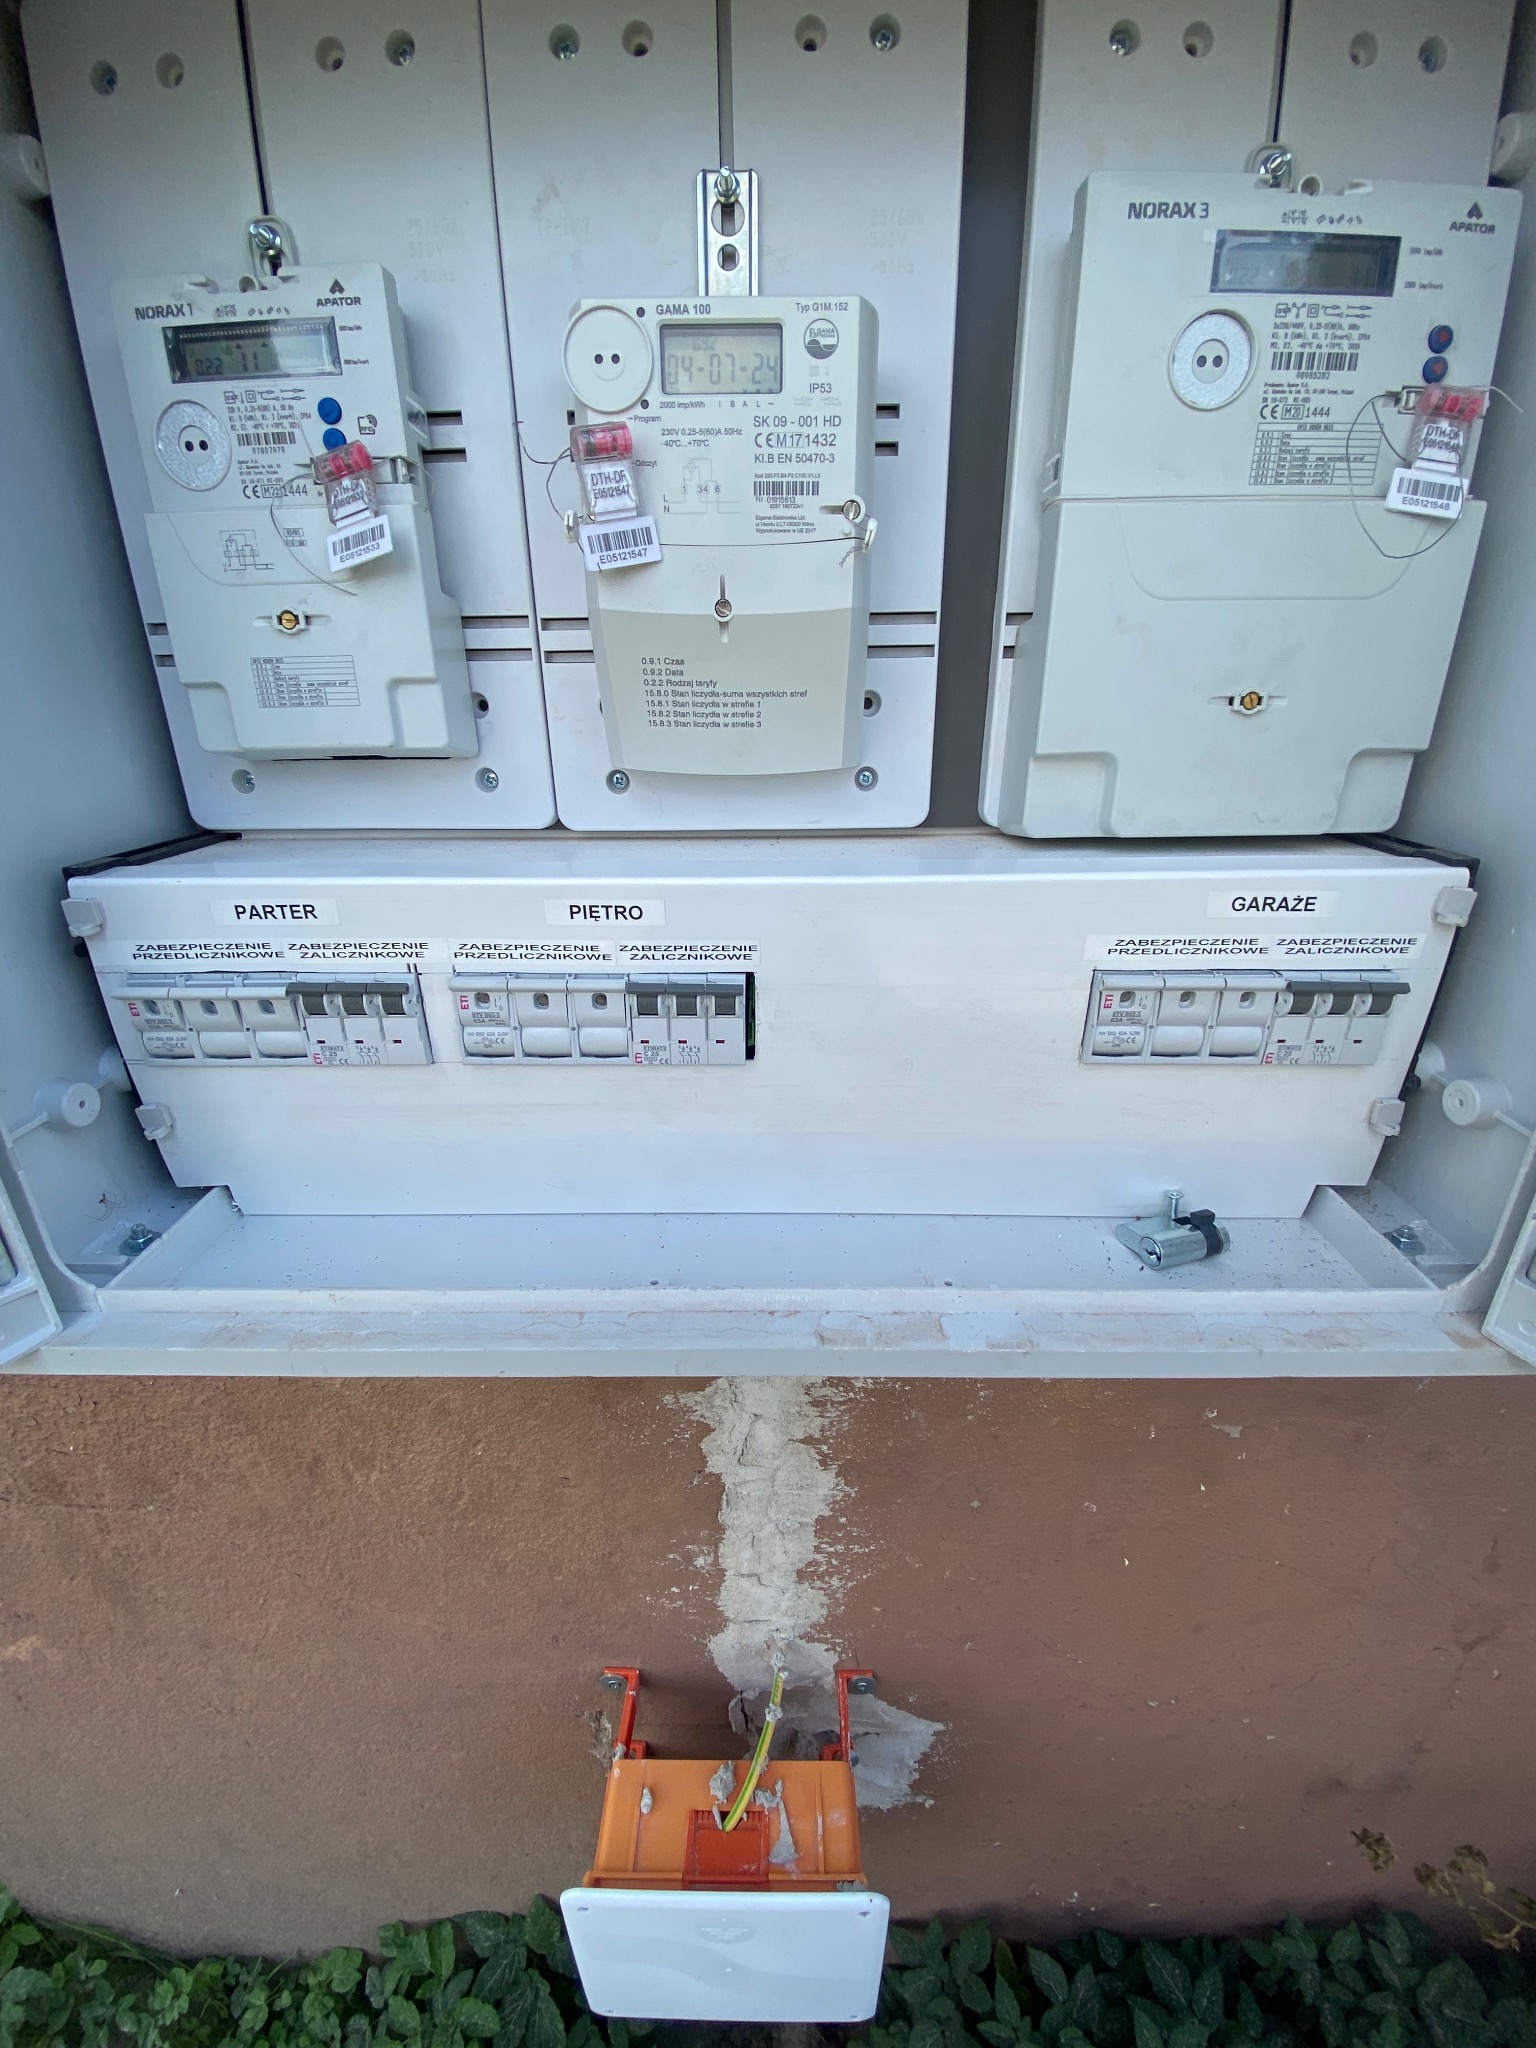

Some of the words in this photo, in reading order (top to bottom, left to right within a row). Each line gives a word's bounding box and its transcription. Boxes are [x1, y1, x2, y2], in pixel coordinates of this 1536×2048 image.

[1450, 222, 1495, 234] APATOR
[316, 296, 362, 308] APATOR
[796, 303, 810, 312] Typ
[812, 303, 848, 311] G1M.152
[656, 304, 689, 315] GAMA
[693, 304, 711, 314] 100
[810, 383, 832, 393] IP53
[1284, 407, 1302, 418] M20
[1306, 407, 1330, 418] 1444
[634, 415, 661, 423] Program
[754, 416, 770, 427] SK
[773, 416, 787, 427] 09
[798, 416, 818, 427] 001
[823, 415, 841, 427] HD
[805, 433, 836, 446] 1432
[252, 446, 285, 454] 97807979
[778, 454, 792, 463] EN
[796, 453, 835, 463] 50470-3
[593, 485, 630, 499] E05121547
[1402, 496, 1450, 510] E05121548
[340, 542, 380, 563] E05121533
[600, 548, 647, 564] E05121547
[666, 679, 694, 688] Rodzaj
[696, 679, 717, 689] taryfy
[746, 690, 788, 699] wszystkich
[1232, 895, 1317, 913] GARAŻE
[234, 904, 318, 919] PARTER
[569, 904, 644, 921] PIĘTRO
[136, 942, 272, 951] ZABEZPIECZENIE
[1115, 938, 1259, 947] ZABEZPIECZENIE
[1276, 937, 1418, 946] ZABEZPIECZENIE
[458, 943, 600, 952] ZABEZPIECZENIE
[1107, 947, 1270, 955] PRZEDLICZNIKOWE
[1284, 946, 1410, 954] ZALICZNIKOWE
[132, 952, 286, 960] PRZEDLICZNIKOWE
[454, 952, 612, 960] PRZEDLICZNIKOWE
[460, 995, 469, 1010] ETI
[1104, 994, 1114, 1009] ETI
[128, 1002, 140, 1016] ETI
[313, 1053, 323, 1064] ETI
[1265, 1053, 1274, 1064] ETI
